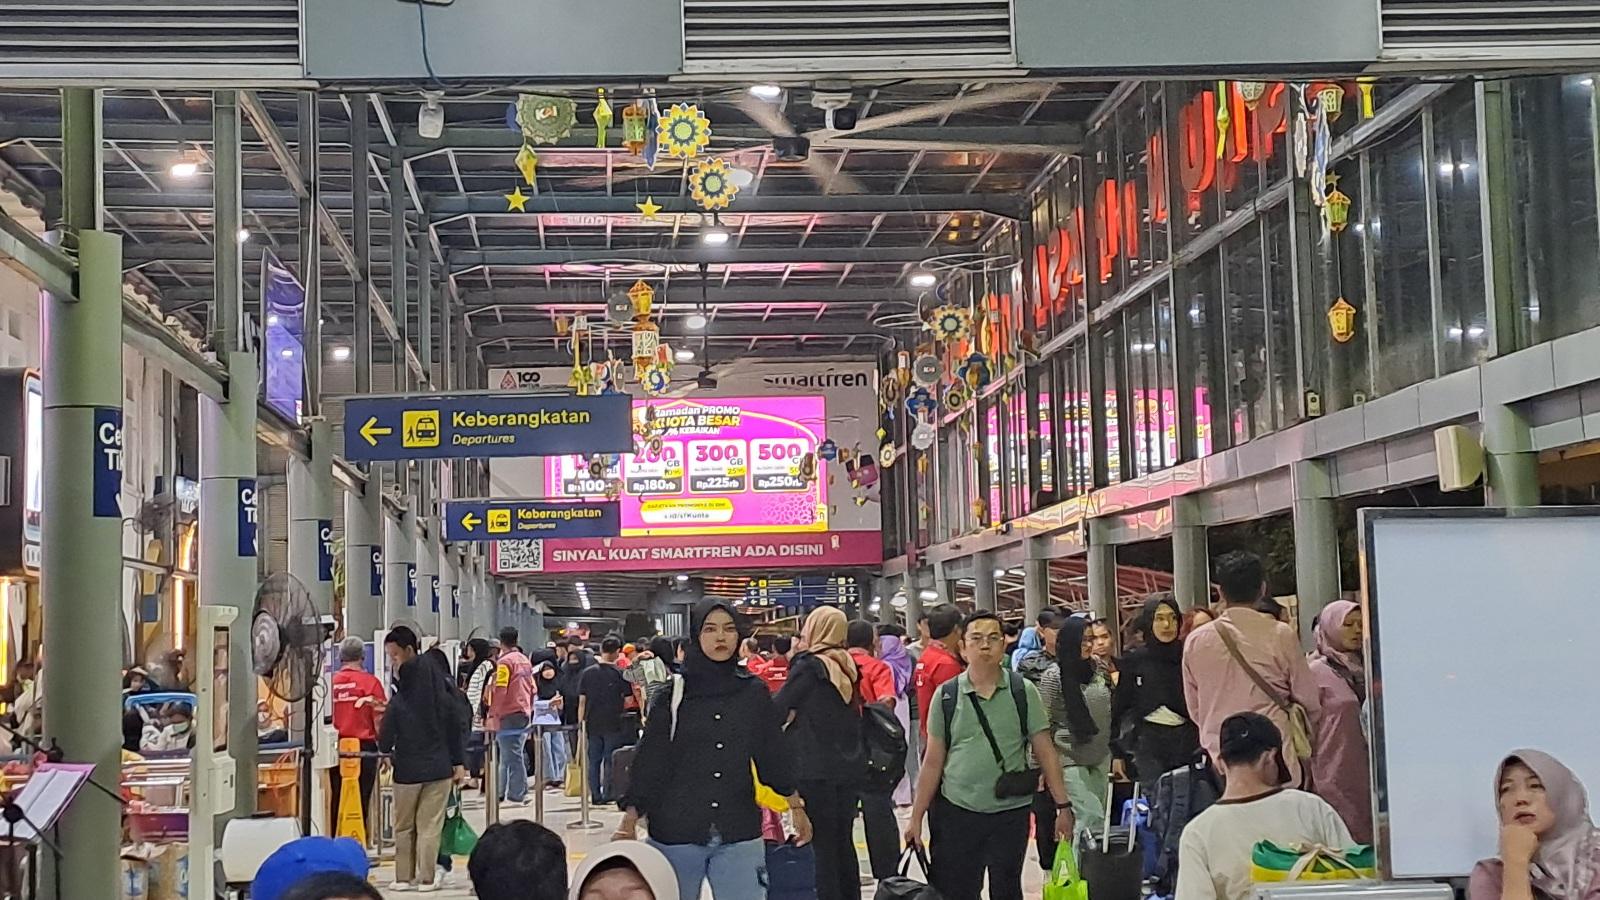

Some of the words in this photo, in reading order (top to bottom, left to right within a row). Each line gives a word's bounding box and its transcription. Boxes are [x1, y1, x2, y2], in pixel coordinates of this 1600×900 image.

[702, 405, 741, 417] PROMO
[452, 409, 591, 429] Keberangkatan
[697, 414, 741, 427] BESAR
[452, 434, 516, 447] Departures
[696, 444, 739, 462] 300
[758, 443, 802, 461] 500
[729, 458, 743, 466] GB
[632, 479, 676, 492] Rp180rb
[696, 477, 740, 490] Rp225rb
[517, 508, 602, 520] Keberangkatan
[552, 550, 607, 562] SINYAL
[609, 548, 649, 561] KUAT
[651, 545, 742, 560] SMARTFREN
[744, 545, 777, 557] ADA
[779, 543, 824, 556] DISINI
